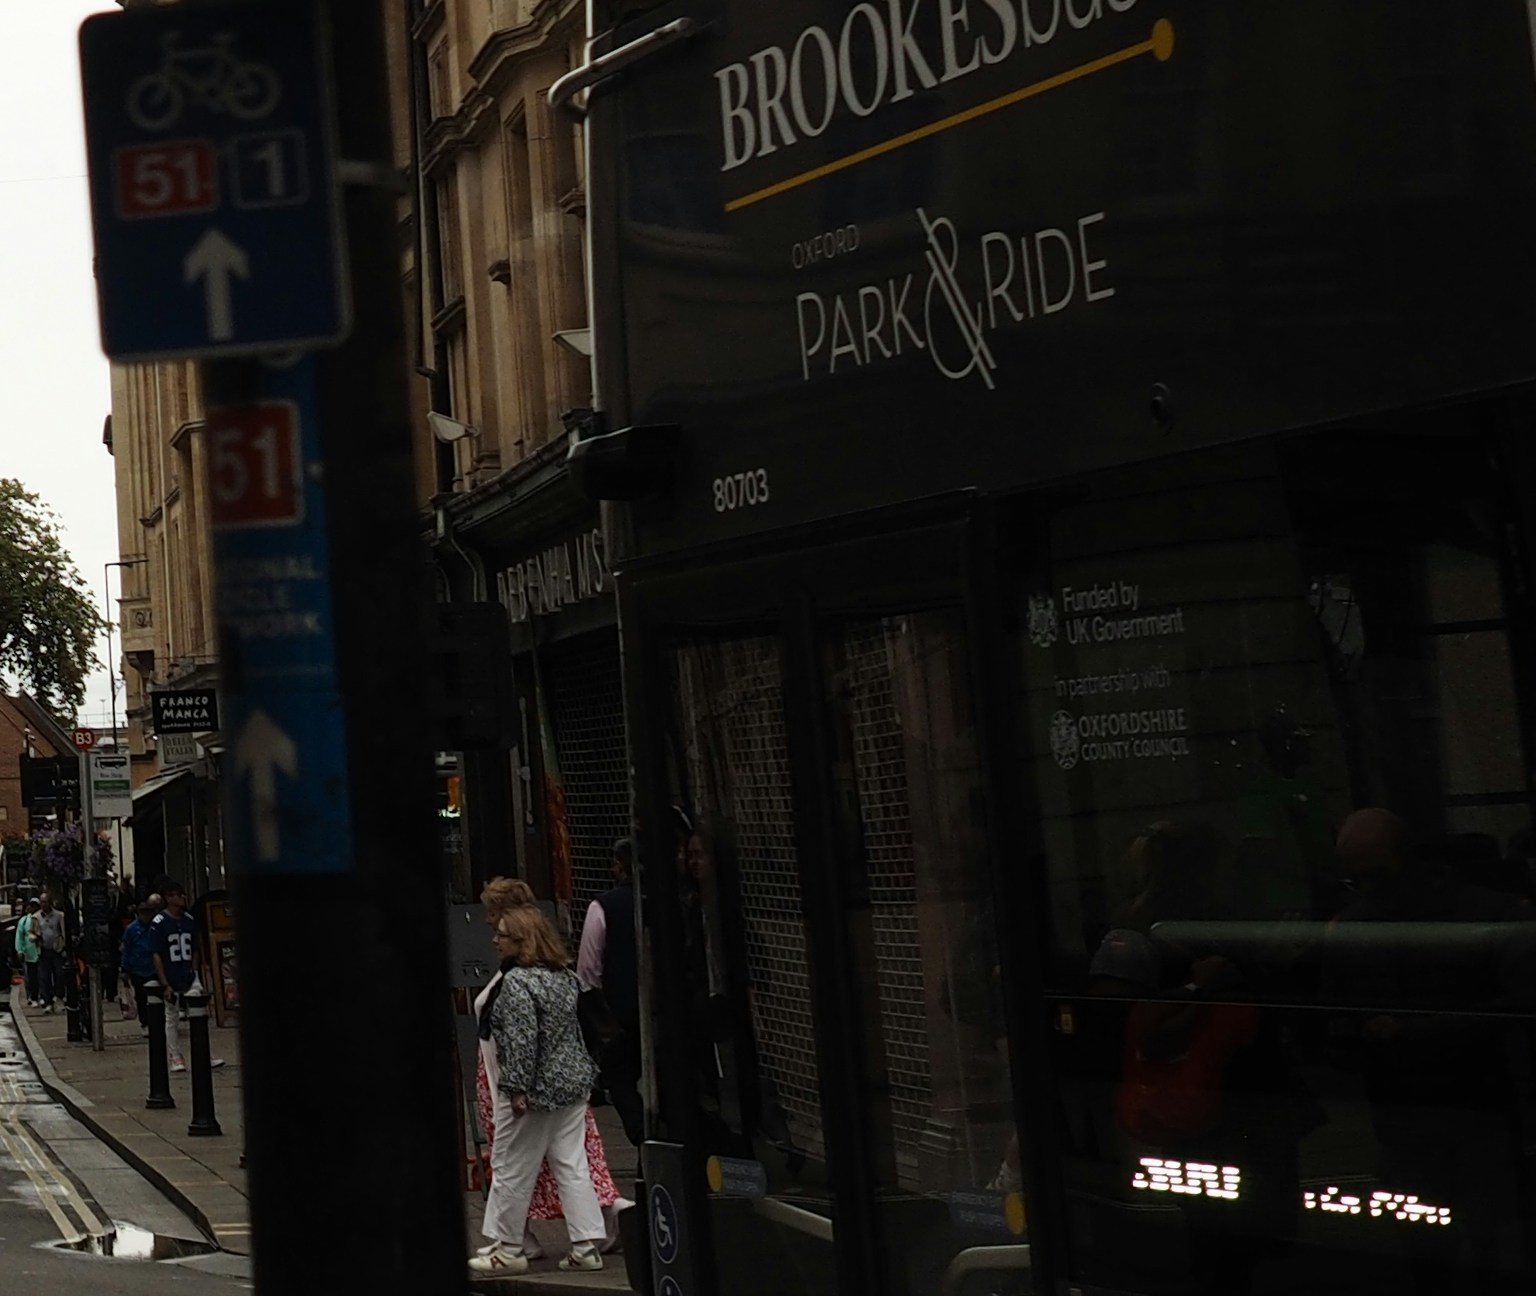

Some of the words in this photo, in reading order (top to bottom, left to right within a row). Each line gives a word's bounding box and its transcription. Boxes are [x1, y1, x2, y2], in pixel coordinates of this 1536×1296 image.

[134, 151, 202, 206] 51
[253, 141, 284, 197] 1
[792, 224, 860, 269] OXFORD
[795, 273, 926, 380] PARK
[981, 211, 1116, 329] RIDE
[211, 425, 280, 502] 51
[713, 467, 770, 513] 80703
[1061, 581, 1118, 612] Funded
[1120, 580, 1139, 611] by
[1066, 618, 1090, 645] UK
[1092, 608, 1185, 642] Government
[1055, 675, 1067, 697] in
[1069, 668, 1139, 701] partnership
[1140, 663, 1171, 690] with
[159, 695, 209, 708] FRANCO
[162, 708, 210, 721] MANCA
[75, 731, 92, 744] B3
[1079, 708, 1188, 738] OXFORDSHIRE
[1081, 741, 1130, 761] COUNTY
[1133, 737, 1190, 758] COUNCIL
[167, 932, 193, 963] 26
